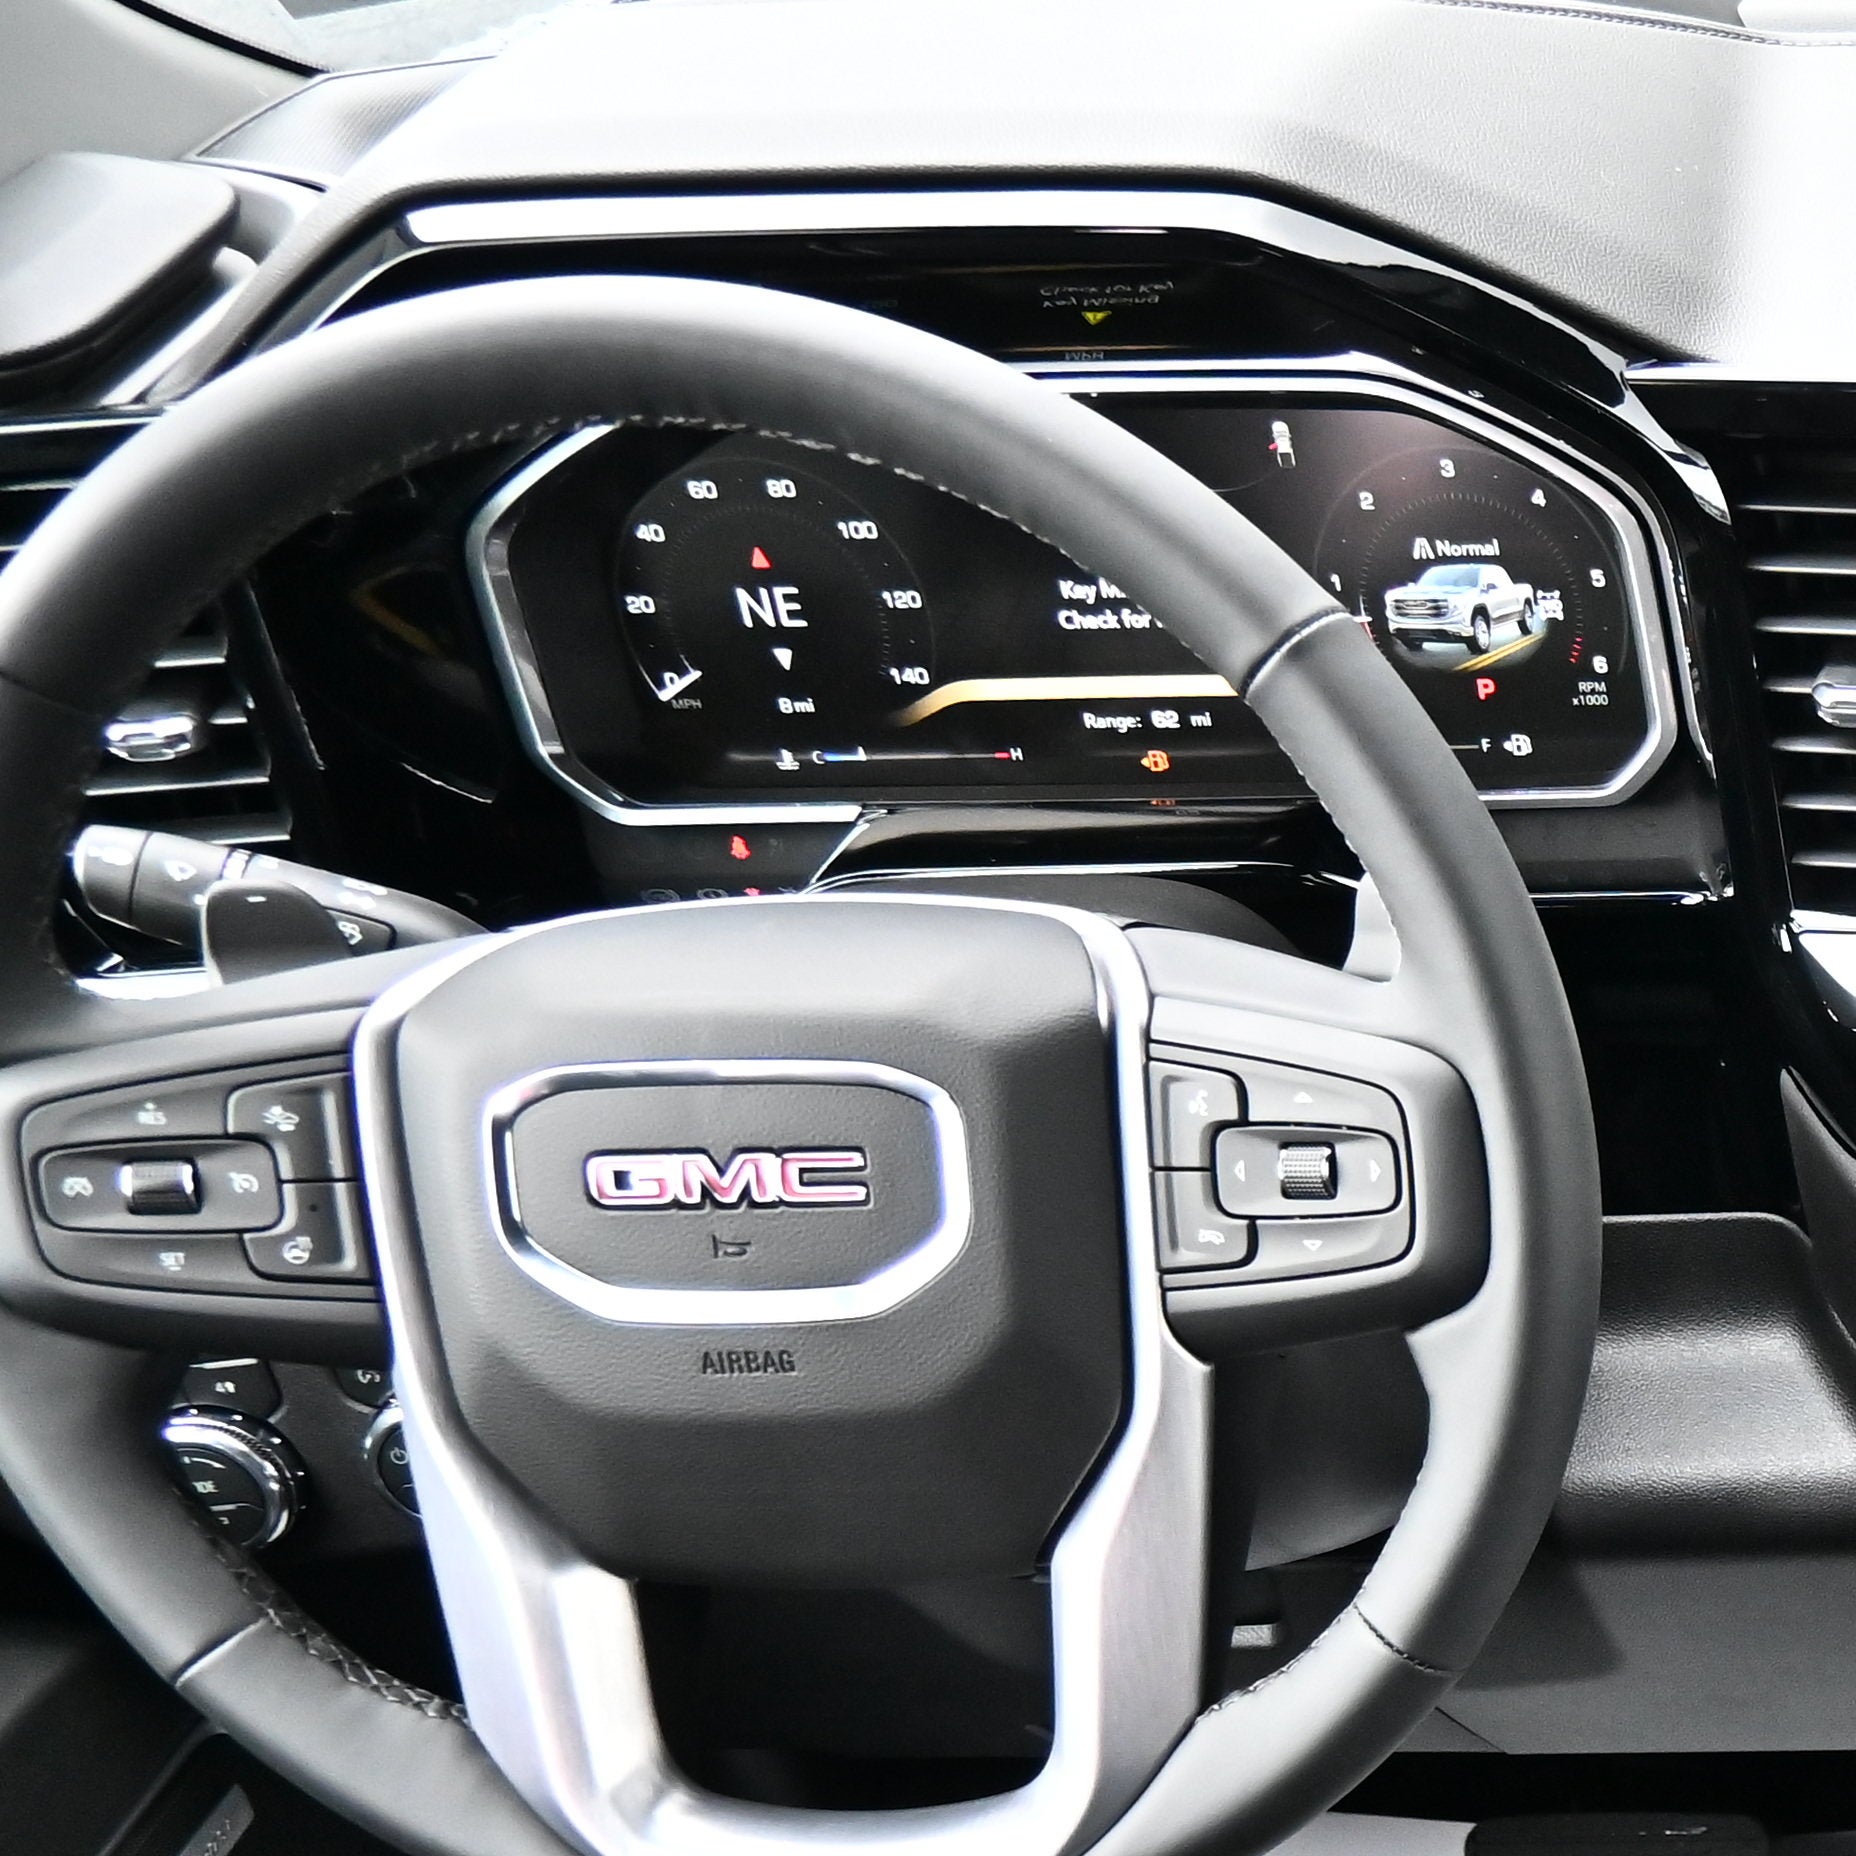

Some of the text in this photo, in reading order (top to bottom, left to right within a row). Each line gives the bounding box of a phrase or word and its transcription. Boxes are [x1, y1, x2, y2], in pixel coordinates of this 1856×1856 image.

[1438, 458, 1456, 479] 3
[686, 479, 719, 500] 60
[765, 478, 797, 499] 80
[1530, 487, 1548, 508] 4
[1358, 491, 1376, 511] 2
[634, 523, 666, 543] 40
[836, 519, 879, 541] 100
[1434, 537, 1501, 558] Normal
[1329, 573, 1343, 593] 1
[1589, 567, 1607, 589] 5
[881, 589, 923, 610] 120
[1058, 579, 1098, 605] Key
[624, 594, 656, 615] 20
[734, 585, 809, 629] NE
[1057, 608, 1153, 630] Check for
[1591, 654, 1610, 674] 6
[888, 665, 930, 686] 140
[1475, 677, 1496, 701] P
[1577, 681, 1608, 694] RPM
[670, 697, 703, 711] MPH
[1571, 694, 1610, 707] x1000
[1081, 710, 1214, 734] Range: 62 mi
[1009, 747, 1025, 762] H
[1480, 737, 1493, 753] F
[811, 750, 826, 765] C
[584, 1150, 869, 1207] GMC
[701, 1349, 797, 1375] AIRBAG
